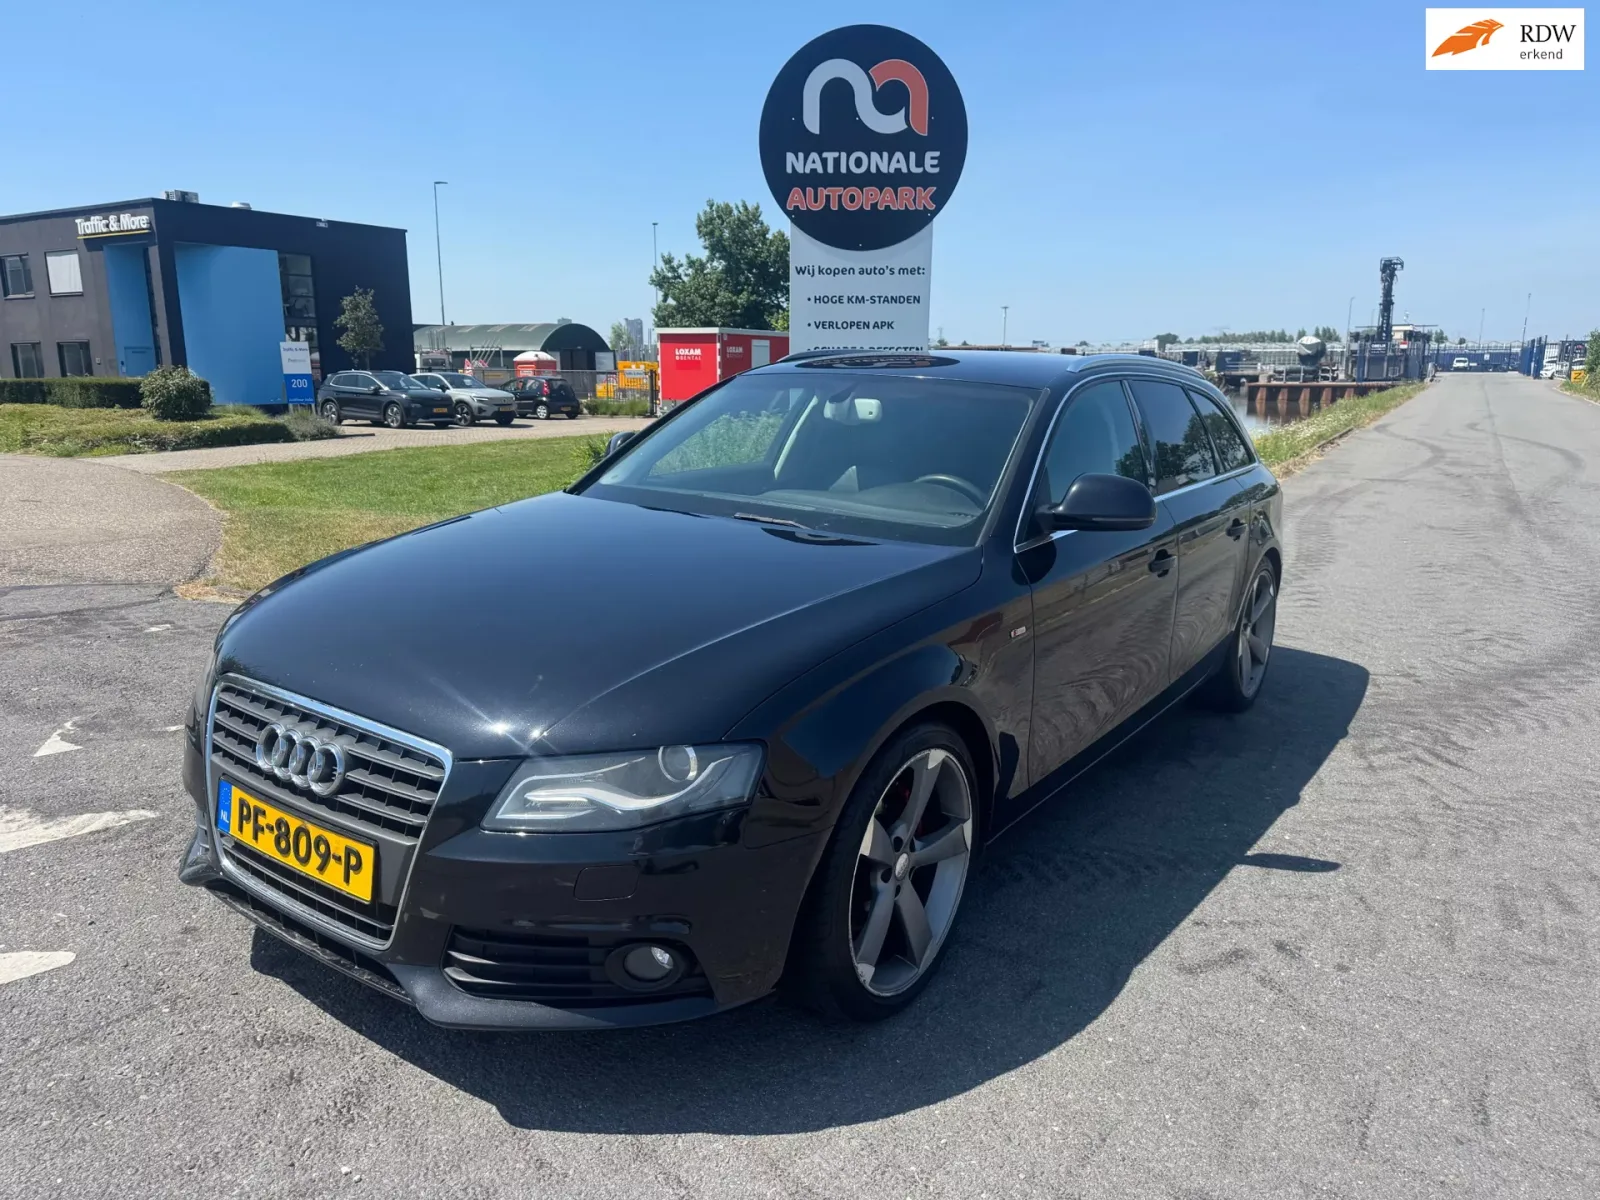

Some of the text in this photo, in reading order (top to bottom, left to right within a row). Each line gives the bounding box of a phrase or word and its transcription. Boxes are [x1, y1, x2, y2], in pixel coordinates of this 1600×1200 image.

[785, 151, 941, 174] NATIONALE
[786, 186, 937, 211] AUTOPARK
[75, 213, 150, 235] Traffic & More
[795, 265, 926, 278] Wij kopen auto's met:
[813, 295, 921, 305] HOGE KM-STANDEN
[814, 320, 895, 330] VERLOPEN APK
[291, 379, 308, 388] 200
[220, 809, 229, 823] NL
[238, 797, 363, 886] PF-809-P
